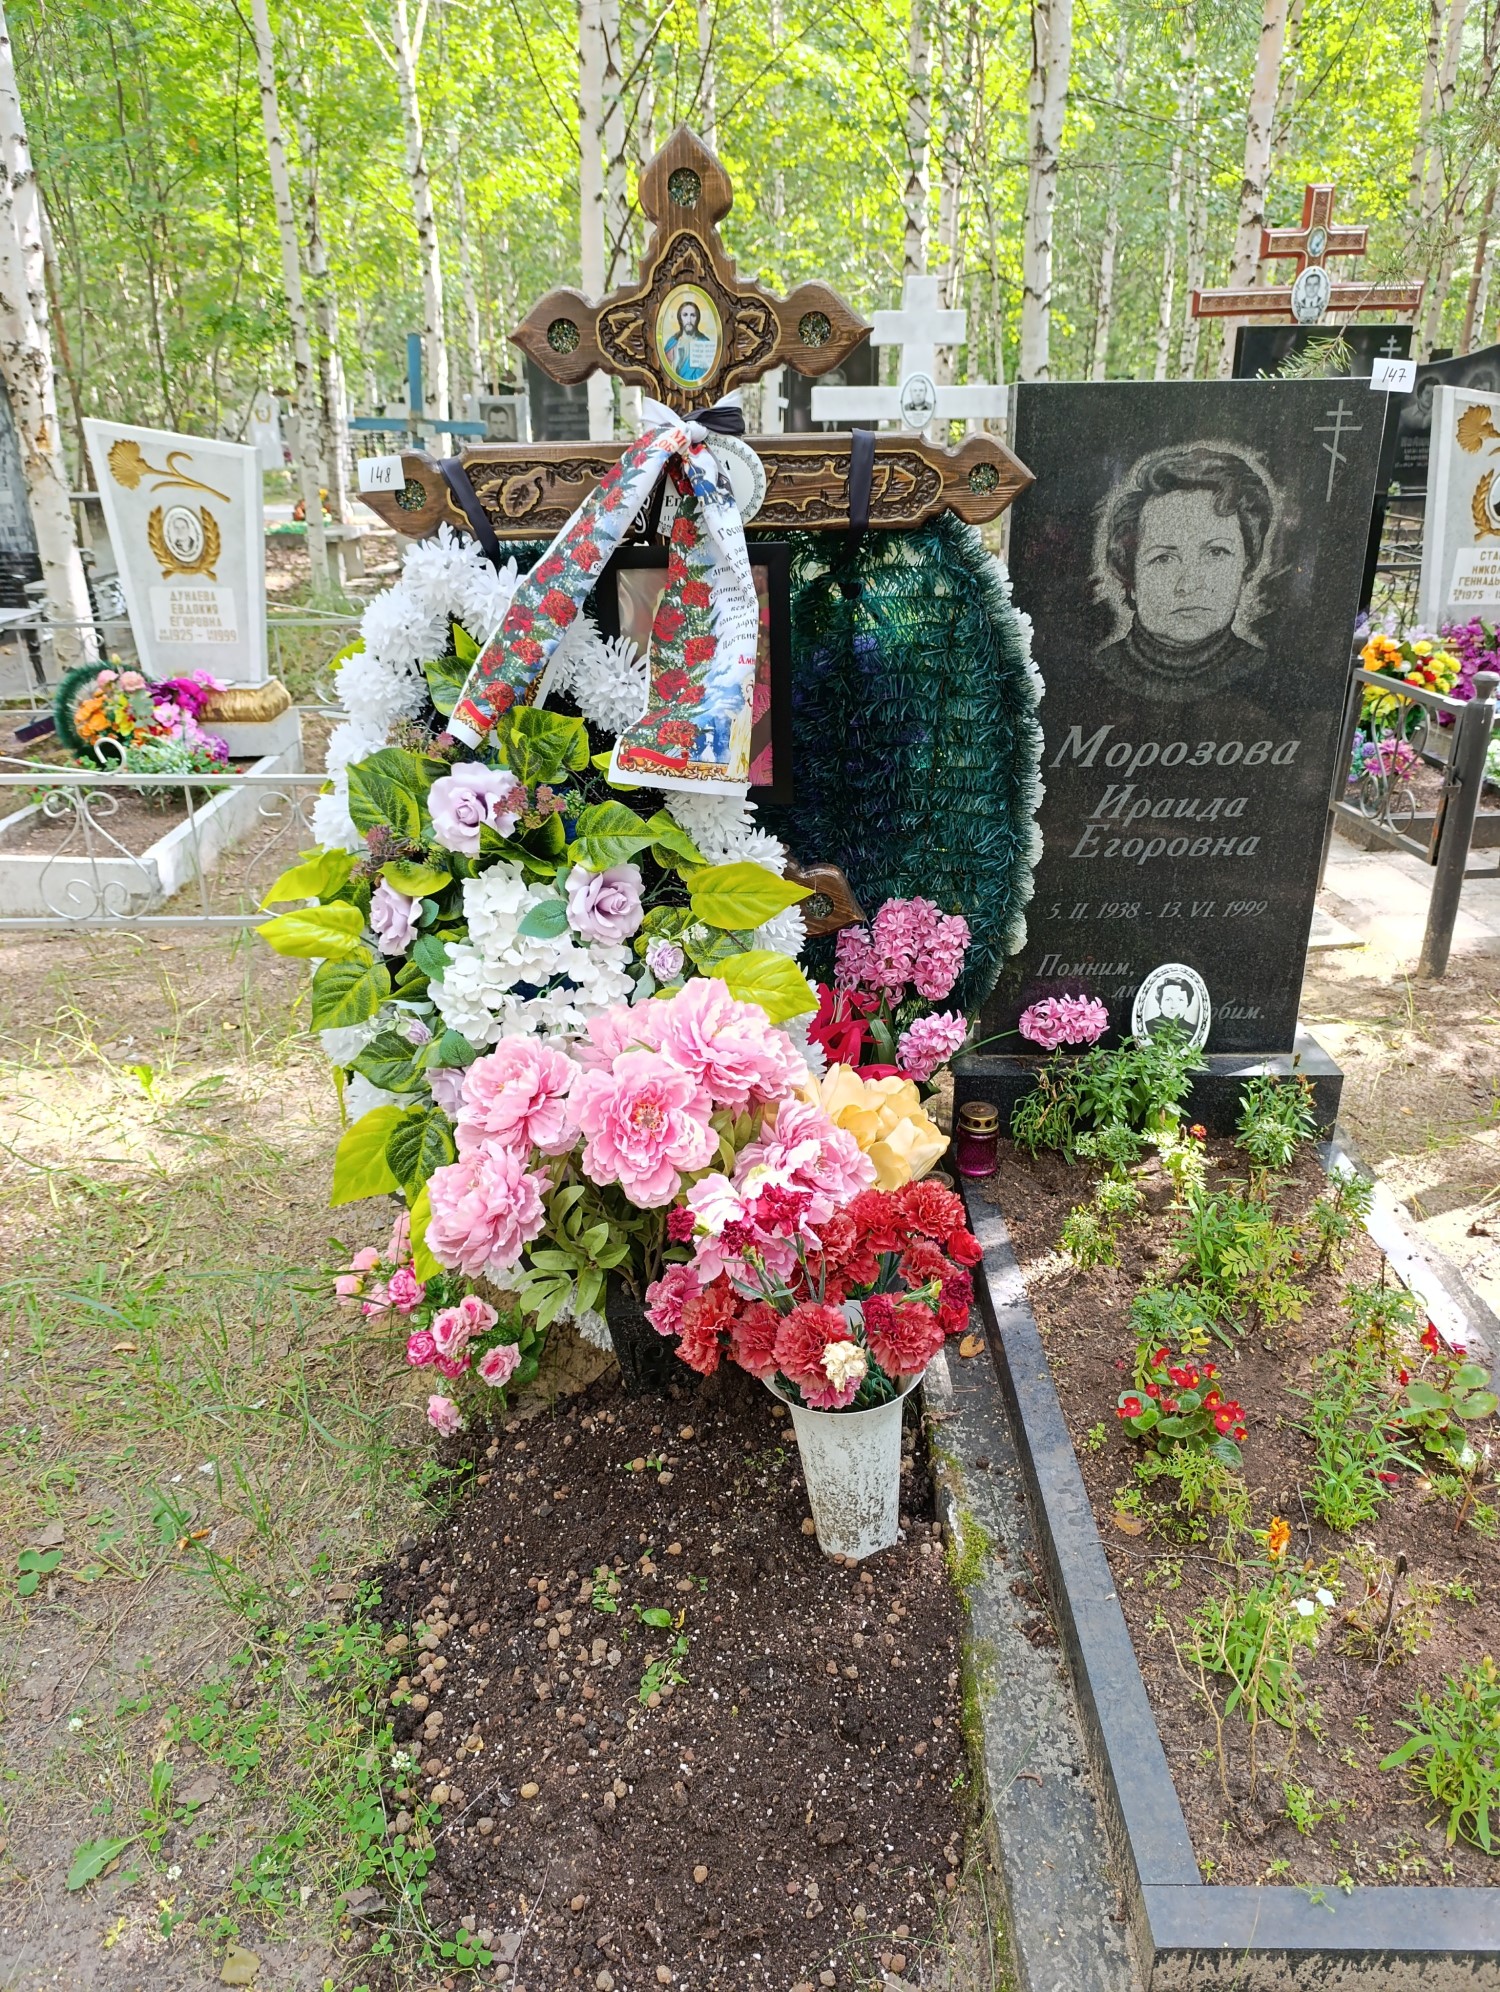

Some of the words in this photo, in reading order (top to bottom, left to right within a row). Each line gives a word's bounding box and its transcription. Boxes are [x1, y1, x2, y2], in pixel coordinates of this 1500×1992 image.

[1382, 366, 1407, 383] 147
[370, 466, 391, 484] 148
[1480, 551, 1500, 561] СТА
[169, 616, 222, 627] ЕГОРОВНА
[1049, 725, 1301, 777] Морозова
[1089, 784, 1249, 827] Ираида
[1069, 824, 1262, 865] Егоровна
[1036, 953, 1136, 978] Помним,
